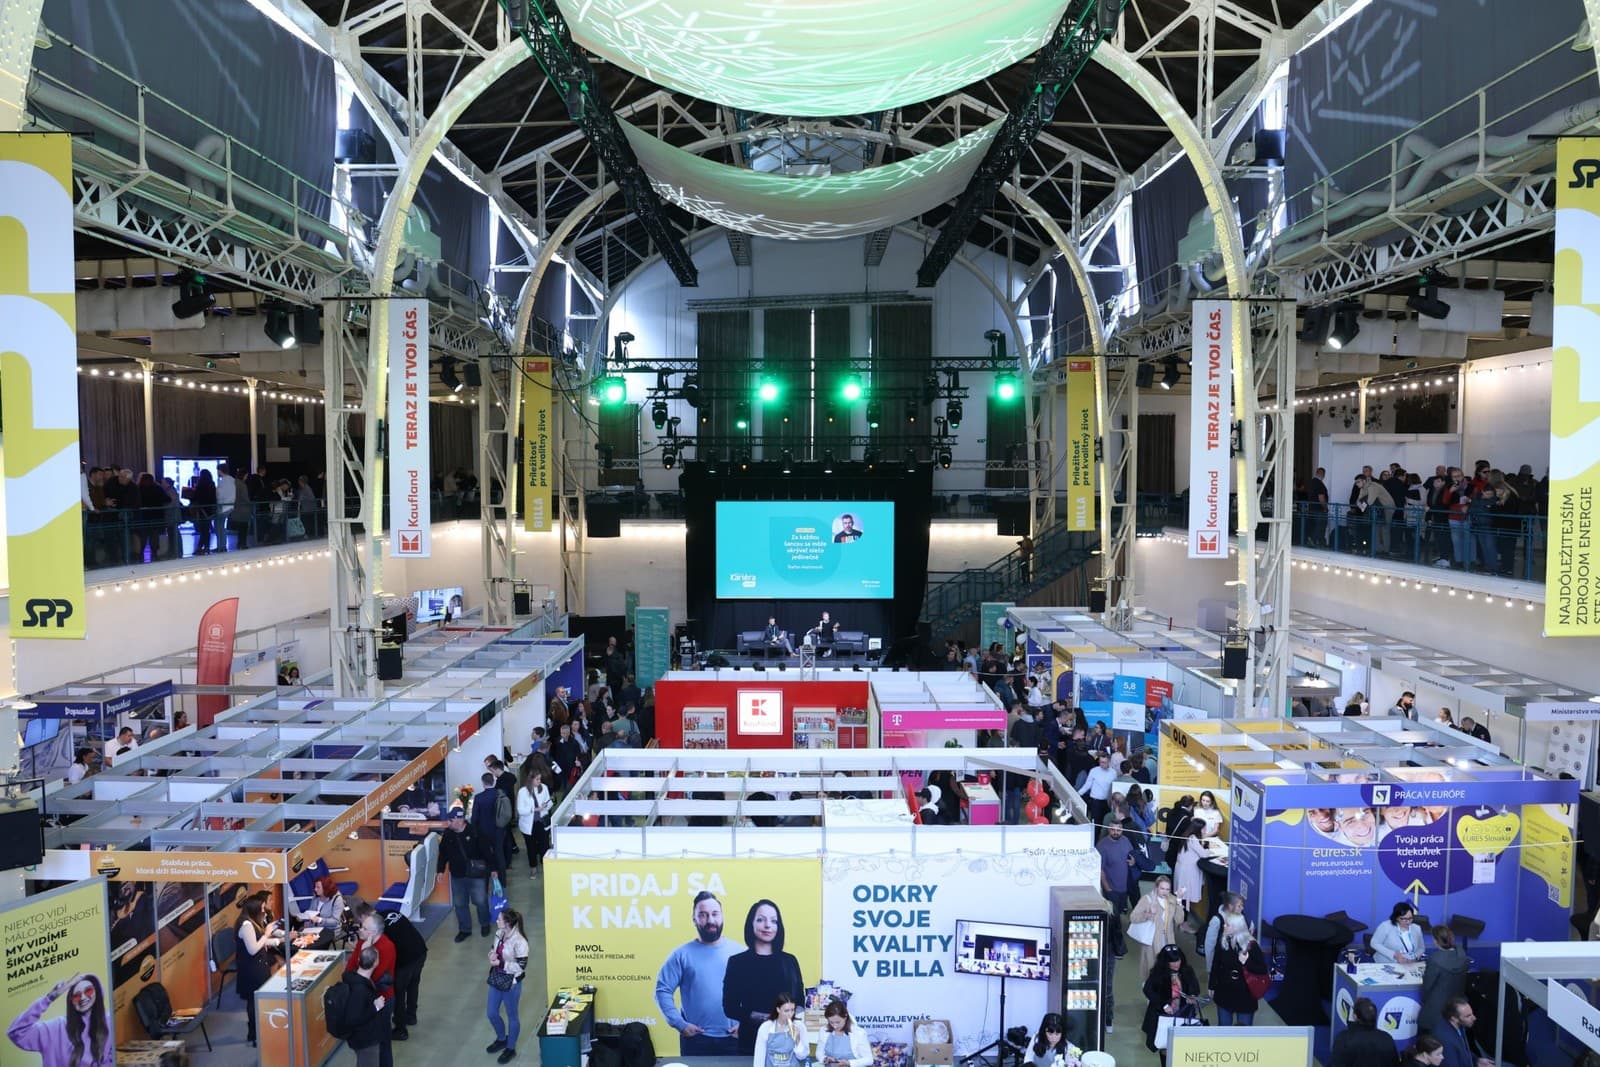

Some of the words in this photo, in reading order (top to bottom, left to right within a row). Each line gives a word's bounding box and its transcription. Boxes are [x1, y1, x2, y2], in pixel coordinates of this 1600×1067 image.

[402, 307, 418, 340] ČAS.
[1206, 309, 1222, 341] ČAS.
[405, 343, 418, 379] TVOJ
[1208, 344, 1221, 380] TVOJ
[406, 383, 418, 397] JE
[1208, 384, 1221, 398] JE
[406, 401, 418, 450] TERAZ
[1081, 408, 1089, 430] život
[1207, 401, 1220, 450] TERAZ
[1081, 433, 1090, 469] kvalitný
[407, 470, 418, 527] Kaufland
[1207, 471, 1218, 527] Kaufland
[1579, 487, 1592, 548] ENERGIE
[1558, 493, 1574, 625] NAJDÔLEŽITEJŠÍM
[1576, 553, 1590, 625] ZDROJOM
[23, 599, 73, 627] SPP
[1173, 729, 1187, 748] OLO
[1395, 790, 1422, 799] PRÁCA
[1424, 790, 1431, 799] V
[1432, 789, 1466, 799] EURÓPE
[1313, 848, 1362, 857] eures.sk
[1395, 835, 1419, 845] Tvoja
[1420, 835, 1444, 844] práca
[1306, 868, 1372, 876] europeanjobdays.eu
[1311, 860, 1363, 868] eures.europa.eu
[1408, 859, 1439, 869] Európe
[571, 873, 679, 897] PRIDAJ
[687, 872, 727, 897] SA
[853, 885, 938, 902] ODKRY
[4, 913, 45, 933] NIEKTO
[47, 903, 67, 918] VIDÍ
[572, 905, 594, 929] K
[601, 898, 672, 929] NÁM
[852, 909, 930, 928] SVOJE
[6, 943, 24, 957] MY
[27, 929, 68, 949] VIDÍME
[6, 942, 58, 969] ŠIKOVNÚ
[853, 935, 953, 952] KVALITY
[7, 947, 79, 981] MANAŽÉRKU
[852, 960, 869, 977] V
[877, 960, 944, 977] BILLA
[1185, 1052, 1232, 1062] NIEKTO
[1234, 1049, 1259, 1062] VIDÍ
